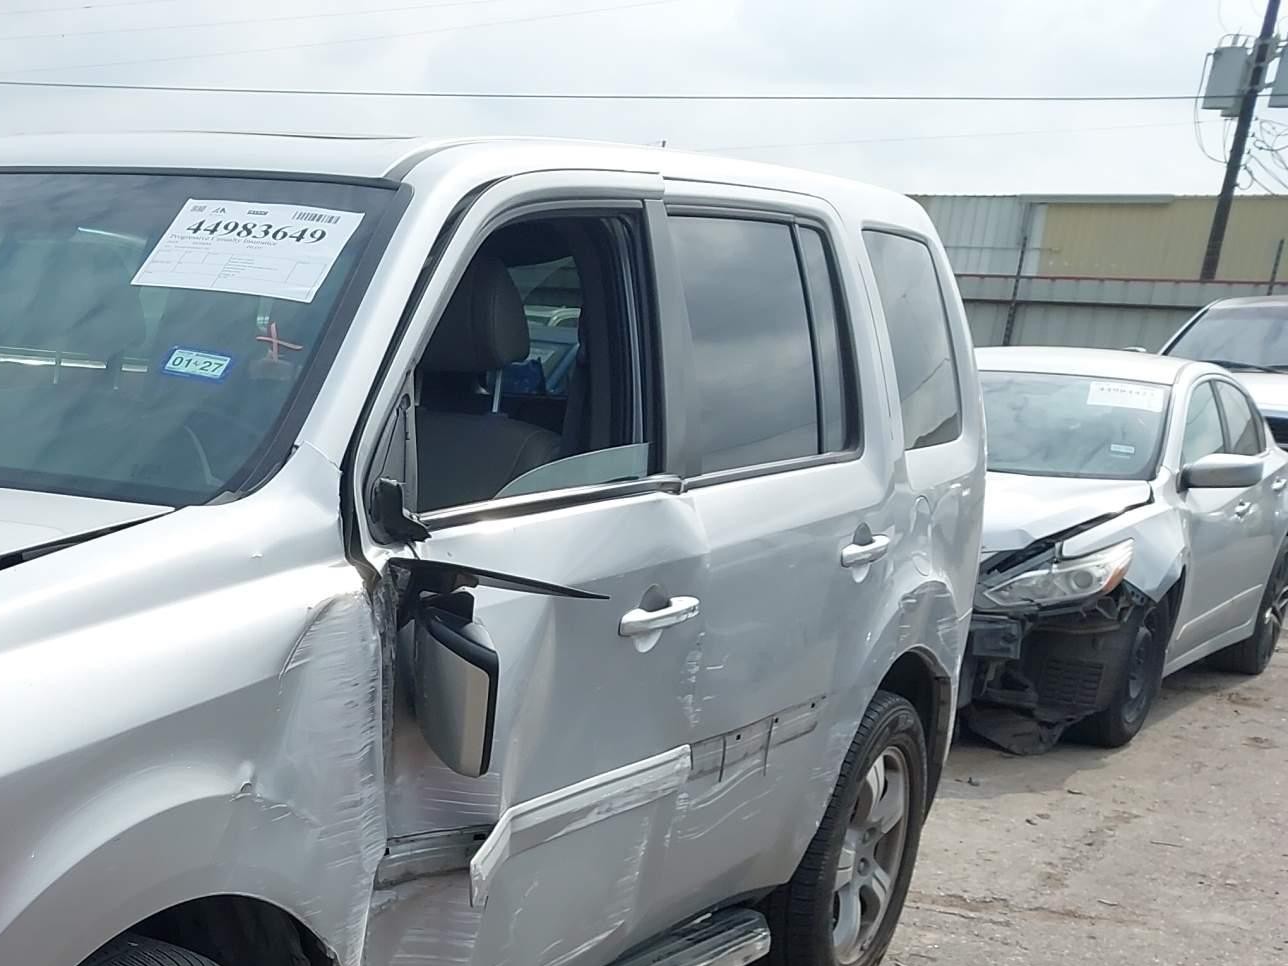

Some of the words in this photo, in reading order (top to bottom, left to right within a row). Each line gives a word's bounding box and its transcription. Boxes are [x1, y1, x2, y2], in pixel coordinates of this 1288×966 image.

[186, 218, 327, 244] 44983649
[171, 356, 193, 369] 01
[199, 360, 223, 373] 27
